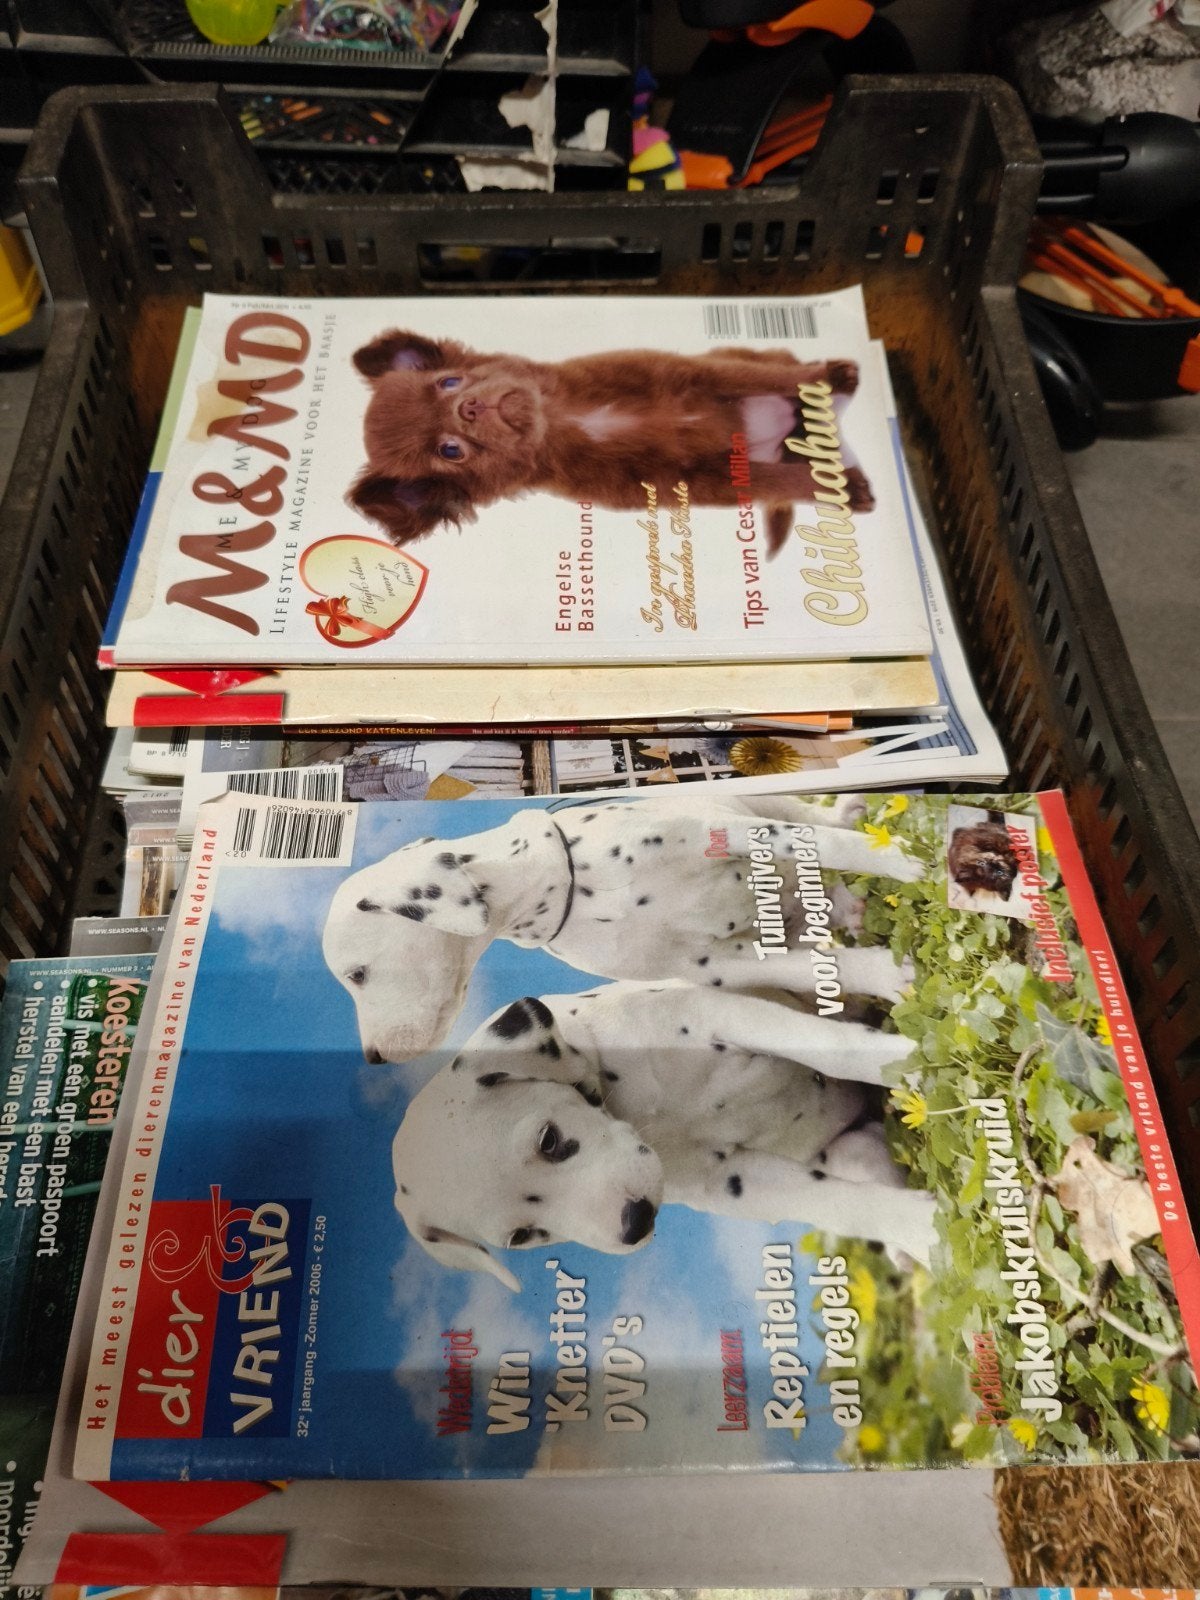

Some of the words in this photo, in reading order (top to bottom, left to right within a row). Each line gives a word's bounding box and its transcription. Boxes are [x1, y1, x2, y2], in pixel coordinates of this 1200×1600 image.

[318, 314, 338, 359] BAASJE
[312, 366, 328, 393] HET
[304, 400, 322, 441] VOOR
[288, 448, 315, 532] MAGAZINE
[729, 432, 752, 487] Millan
[640, 481, 659, 519] met
[734, 489, 757, 543] Cesar
[785, 380, 869, 627] Chihuahua
[269, 541, 299, 635] LIFESTYLE
[555, 550, 577, 632] Engelse
[578, 499, 595, 632] Bassethound
[636, 519, 680, 609] gesprek
[742, 548, 760, 582] van
[640, 603, 664, 633] In
[743, 590, 770, 629] Tips
[184, 828, 219, 927] Nederland
[788, 823, 835, 945] beginners
[1006, 824, 1049, 887] poster
[745, 825, 790, 962] Tuinvijvers
[178, 936, 197, 969] van
[1020, 891, 1075, 983] Inclusief
[77, 994, 99, 1020] vis
[810, 948, 845, 1017] voor
[1090, 948, 1124, 1017] huisdier!
[14, 996, 46, 1060] herstel
[40, 995, 69, 1076] aandelen
[71, 1023, 91, 1059] met
[87, 977, 143, 1126] Koesteren
[1114, 1022, 1133, 1039] je
[1120, 1044, 1141, 1073] van
[6, 1063, 29, 1097] van
[30, 1080, 54, 1117] met
[61, 1063, 85, 1097] een
[136, 979, 187, 1159] dierenmagazine
[0, 1101, 21, 1136] een
[22, 1122, 45, 1158] een
[53, 1102, 78, 1158] groen
[1129, 1080, 1158, 1136] vriend
[14, 1163, 43, 1209] bast
[1146, 1143, 1172, 1191] beste
[36, 1163, 67, 1259] paspoort
[118, 1171, 148, 1270] gelezen
[1162, 1199, 1180, 1222] De
[968, 1096, 1063, 1424] Jakobskruiskruid
[100, 1283, 129, 1367] meest
[230, 1201, 293, 1436] VRIEND
[298, 1350, 317, 1413] jaargang
[309, 1262, 322, 1297] 2006
[755, 1242, 810, 1430] Reptielen
[808, 1254, 861, 1369] regels
[137, 1287, 205, 1427] dier
[544, 1258, 590, 1434] 'Knetter'
[602, 1314, 648, 1433] DVD's
[86, 1383, 113, 1430] Het
[486, 1350, 532, 1436] Win
[830, 1378, 865, 1429] en
